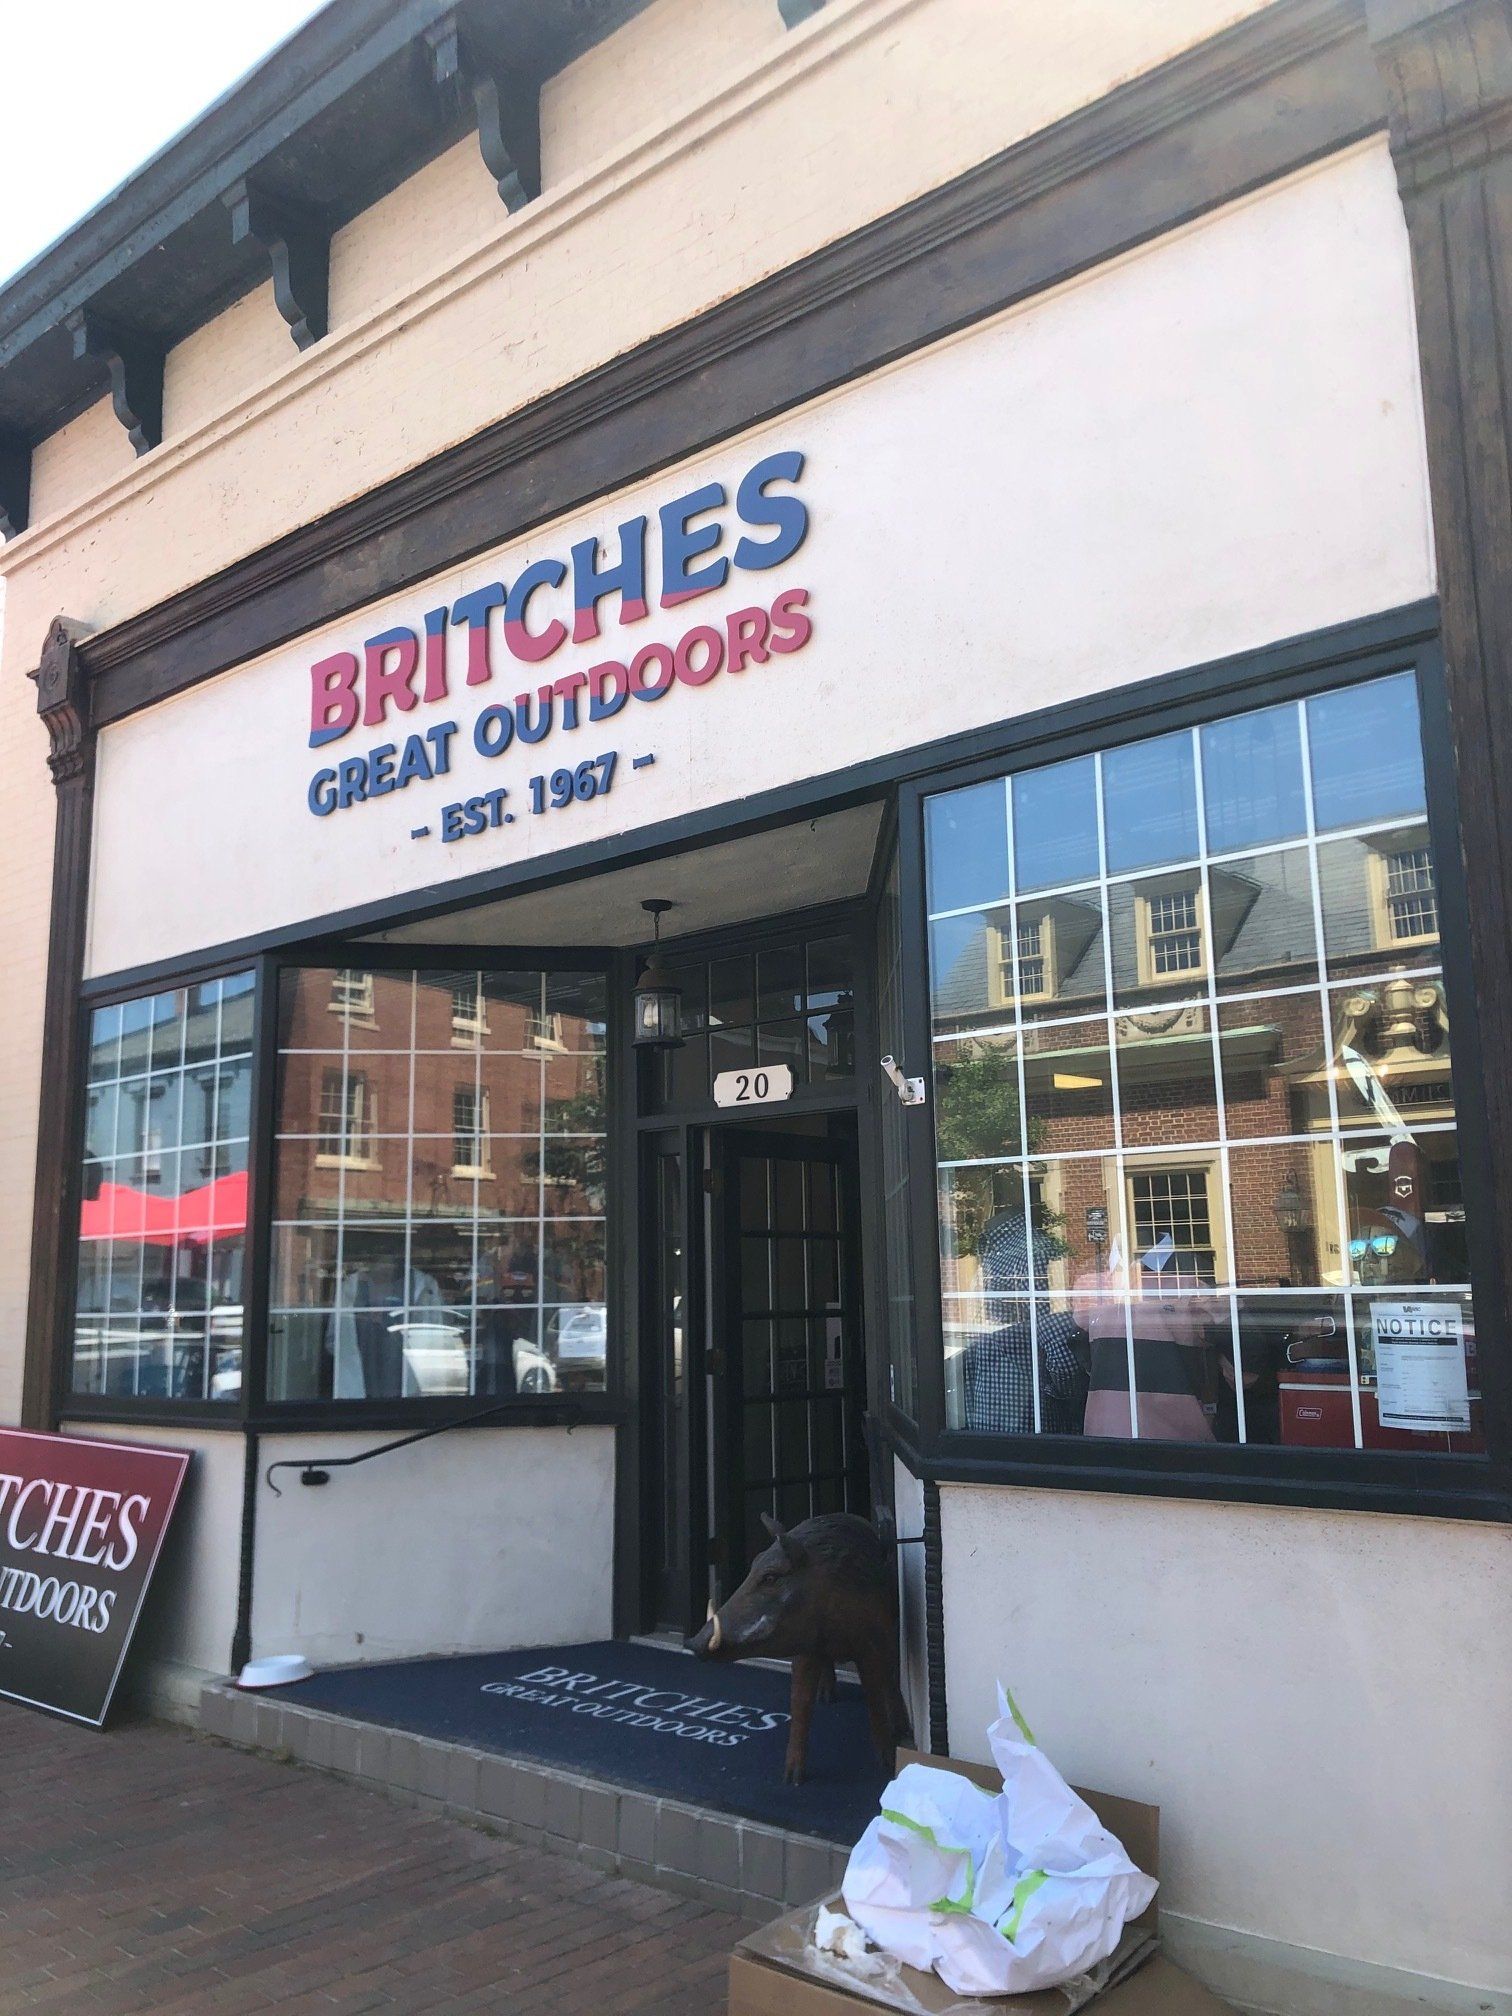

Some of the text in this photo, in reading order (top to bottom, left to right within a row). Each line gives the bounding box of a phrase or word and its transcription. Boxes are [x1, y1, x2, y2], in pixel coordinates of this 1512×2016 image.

[308, 450, 809, 748] BRITCHES
[307, 588, 812, 816] GREAT OUTDOORS
[441, 788, 514, 843] EST.
[529, 750, 618, 815] 1967
[735, 1073, 769, 1102] 20
[1376, 1318, 1457, 1336] NOTICE
[480, 1681, 750, 1746] GREAT OUTDOORS
[514, 1665, 792, 1731] BRITCHES
